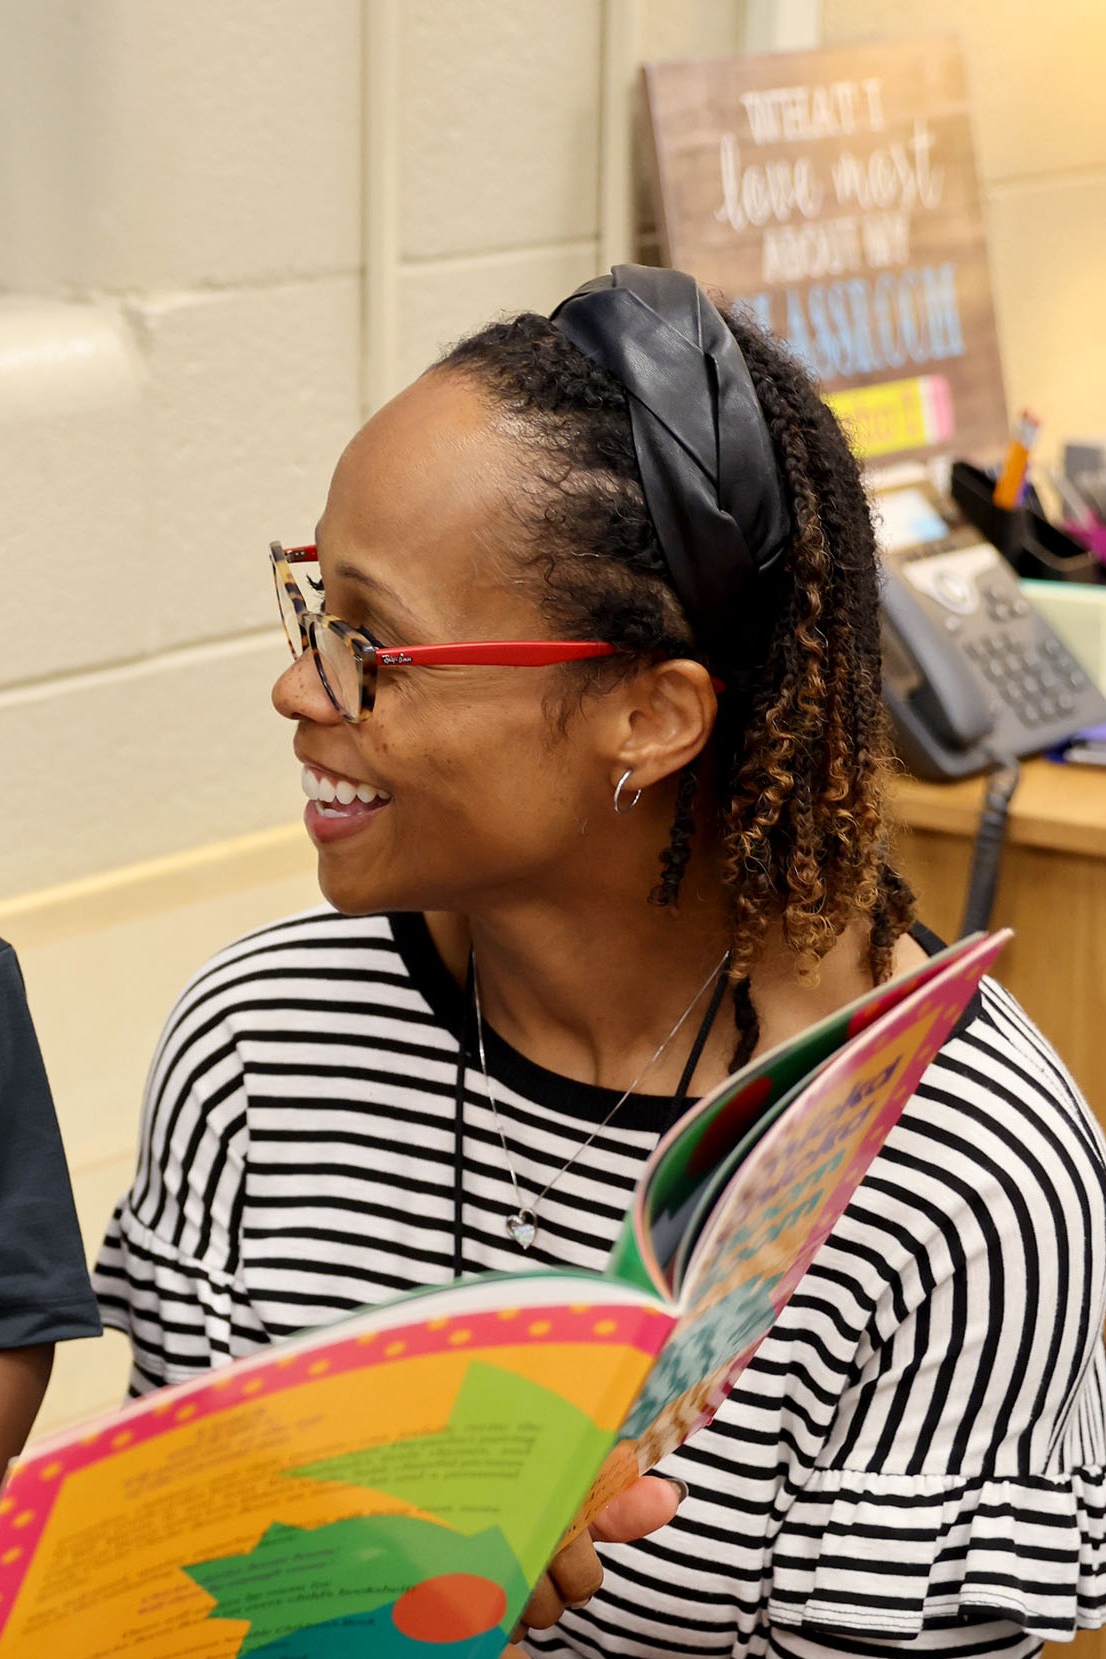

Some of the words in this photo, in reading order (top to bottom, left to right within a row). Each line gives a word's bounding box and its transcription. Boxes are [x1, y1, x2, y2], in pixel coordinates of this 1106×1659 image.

[740, 79, 856, 143] WHAT
[714, 132, 824, 233] love
[831, 118, 945, 210] most
